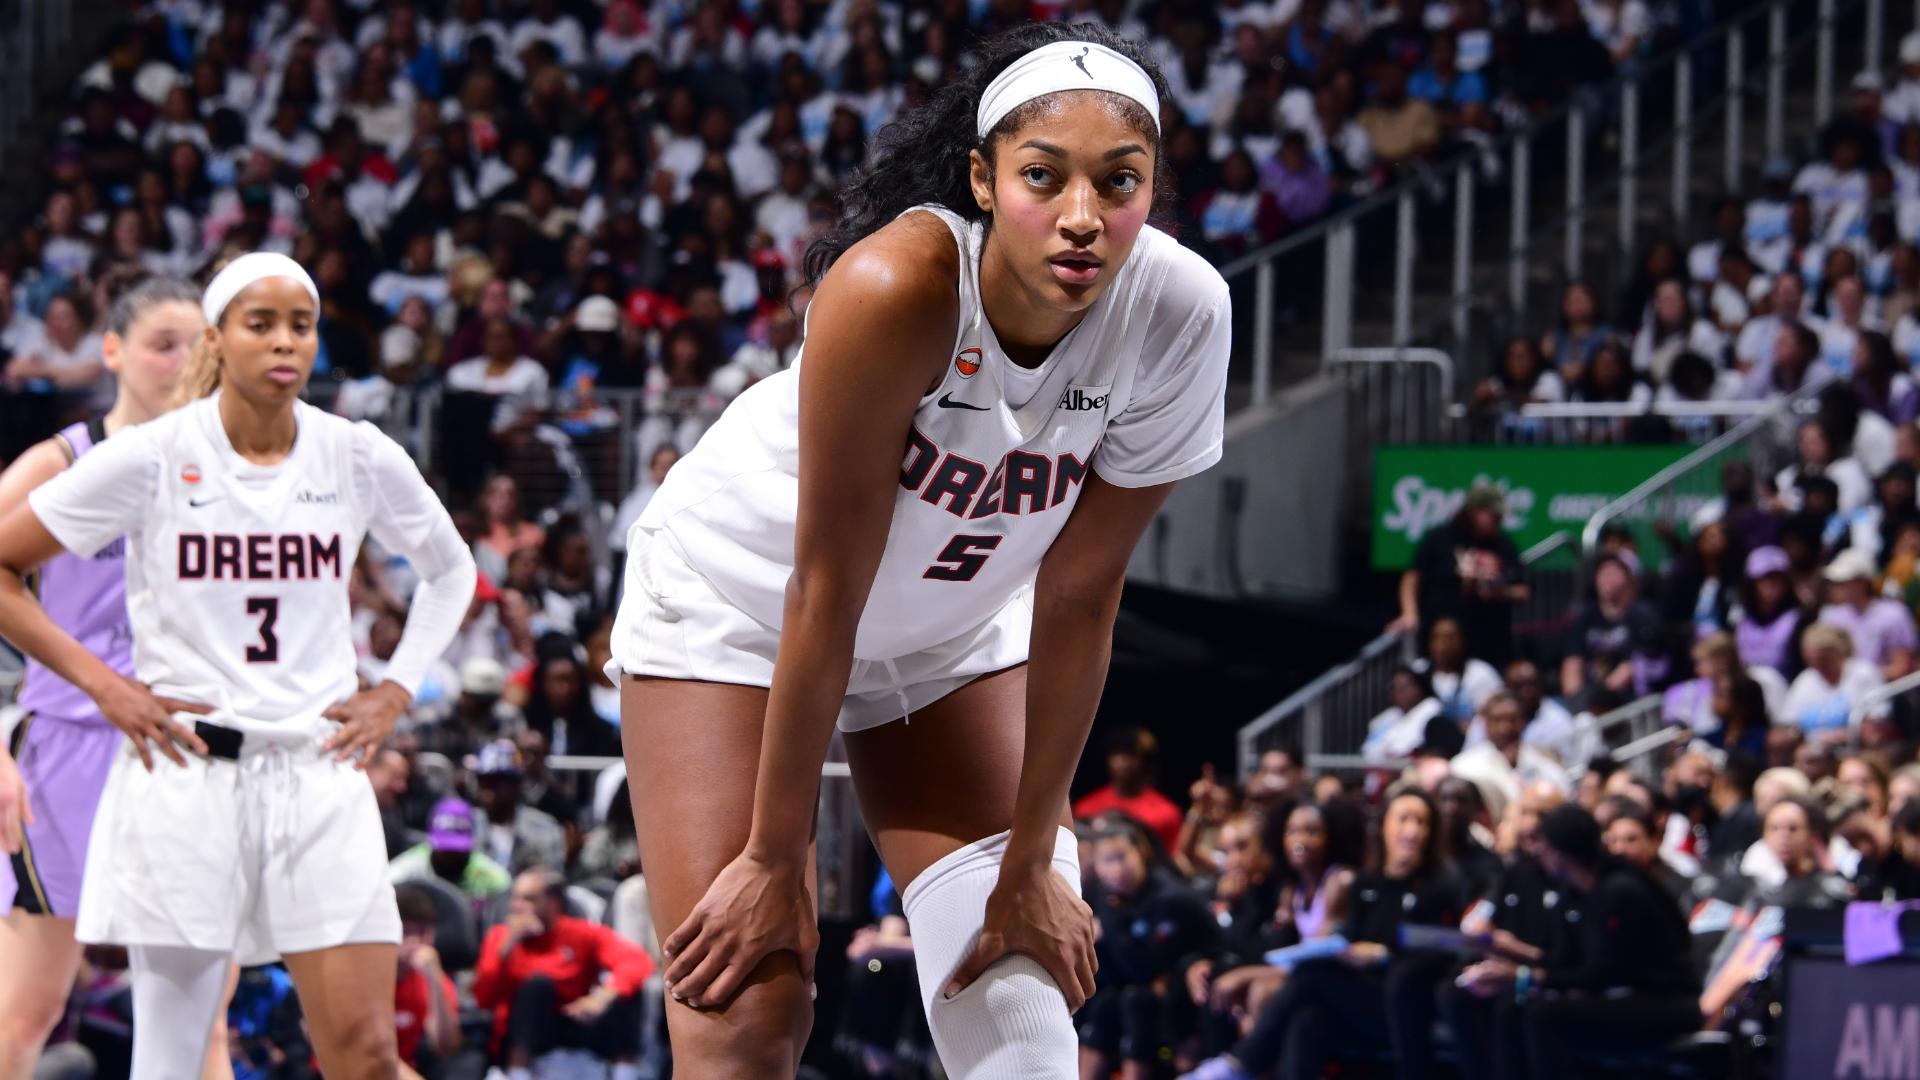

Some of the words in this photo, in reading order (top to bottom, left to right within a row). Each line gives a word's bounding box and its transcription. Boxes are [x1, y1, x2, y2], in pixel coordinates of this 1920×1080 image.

[178, 533, 341, 581] DREAM
[922, 533, 1003, 582] 5
[245, 596, 279, 663] 3
